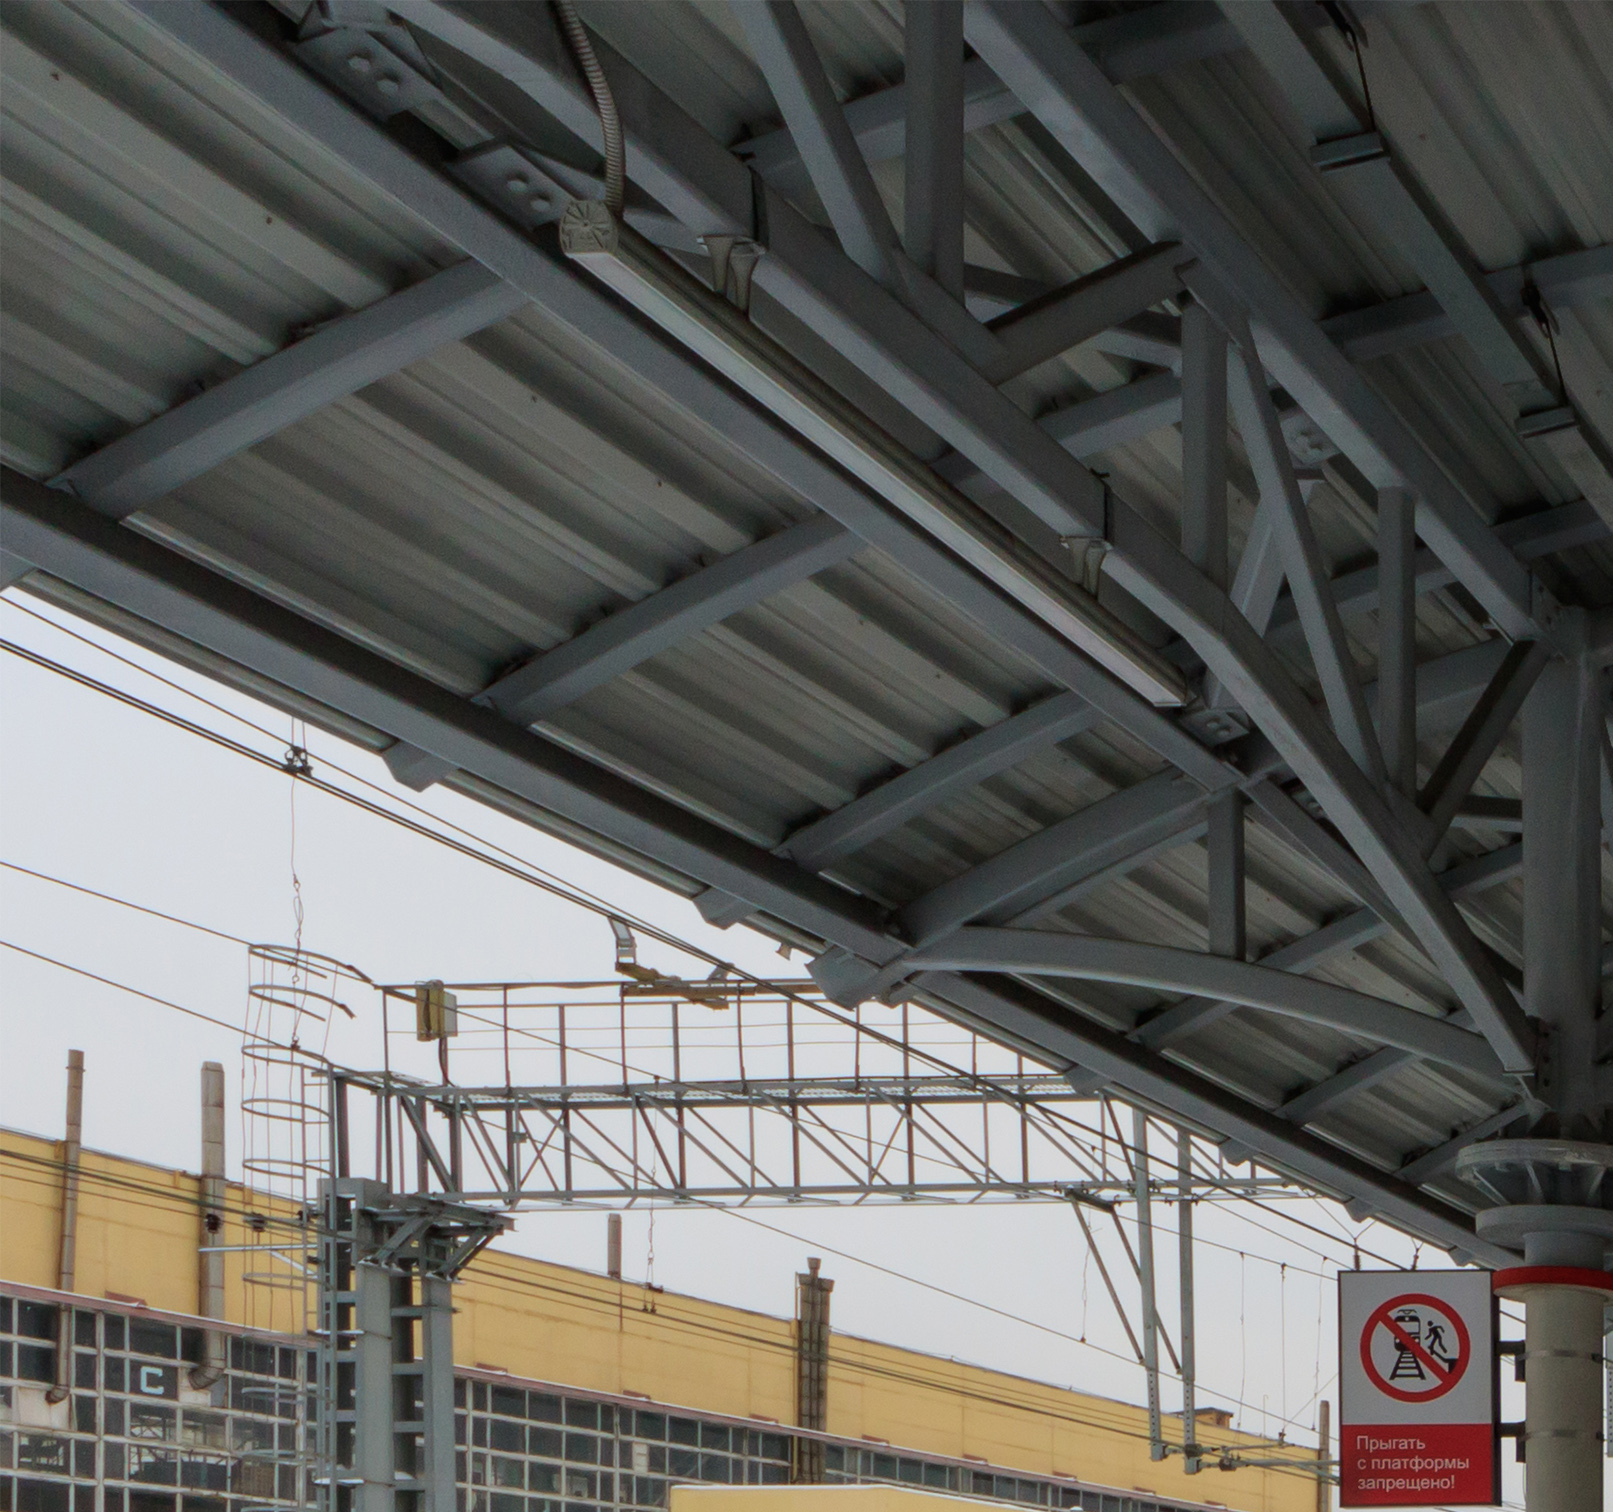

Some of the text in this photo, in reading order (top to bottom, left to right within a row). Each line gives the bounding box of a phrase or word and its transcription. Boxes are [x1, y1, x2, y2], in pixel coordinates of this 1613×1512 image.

[1356, 1436, 1426, 1452] Прыгать
[1357, 1455, 1470, 1473] с платформы
[1357, 1475, 1455, 1492] запрещено!
